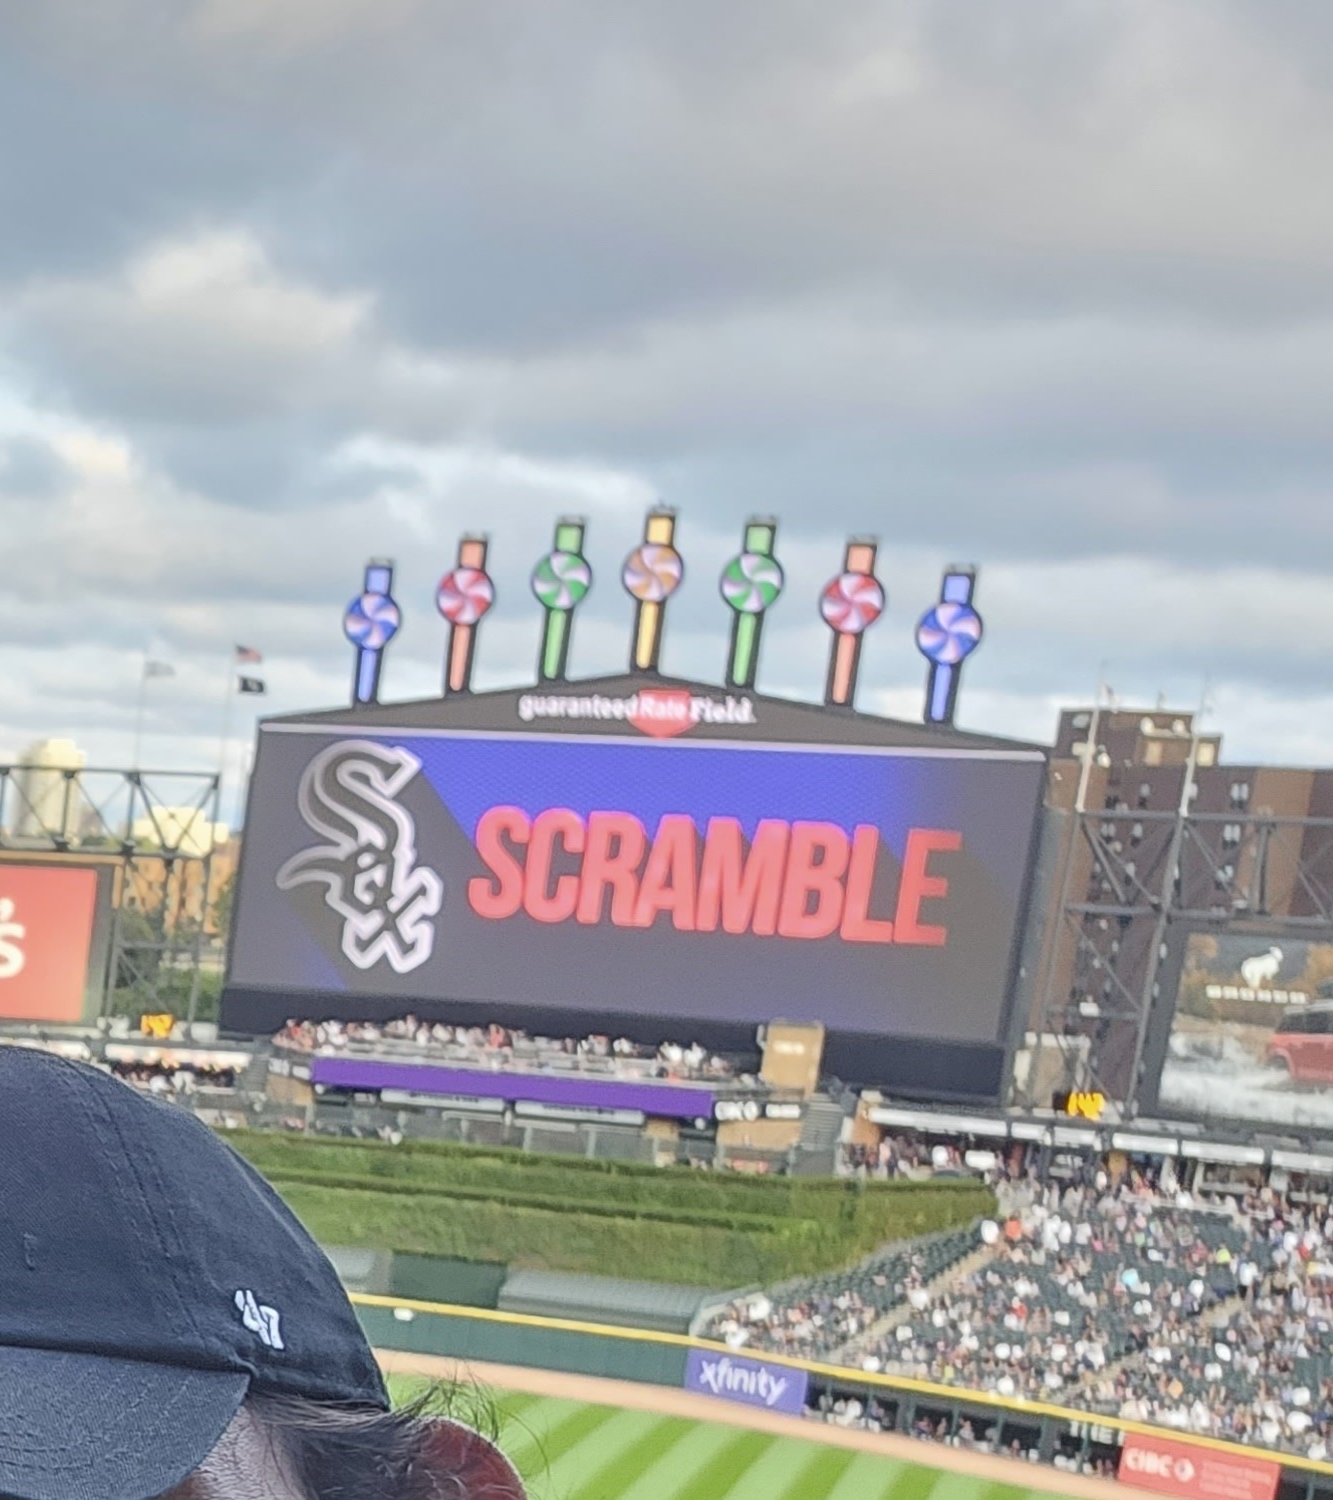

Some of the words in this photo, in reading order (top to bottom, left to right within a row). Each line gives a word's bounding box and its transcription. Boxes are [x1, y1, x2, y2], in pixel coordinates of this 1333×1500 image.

[518, 694, 639, 722] guaranteed
[467, 804, 965, 947] SCRAMBLE
[699, 1357, 788, 1406] xfinity
[1125, 1447, 1174, 1479] CIBC
